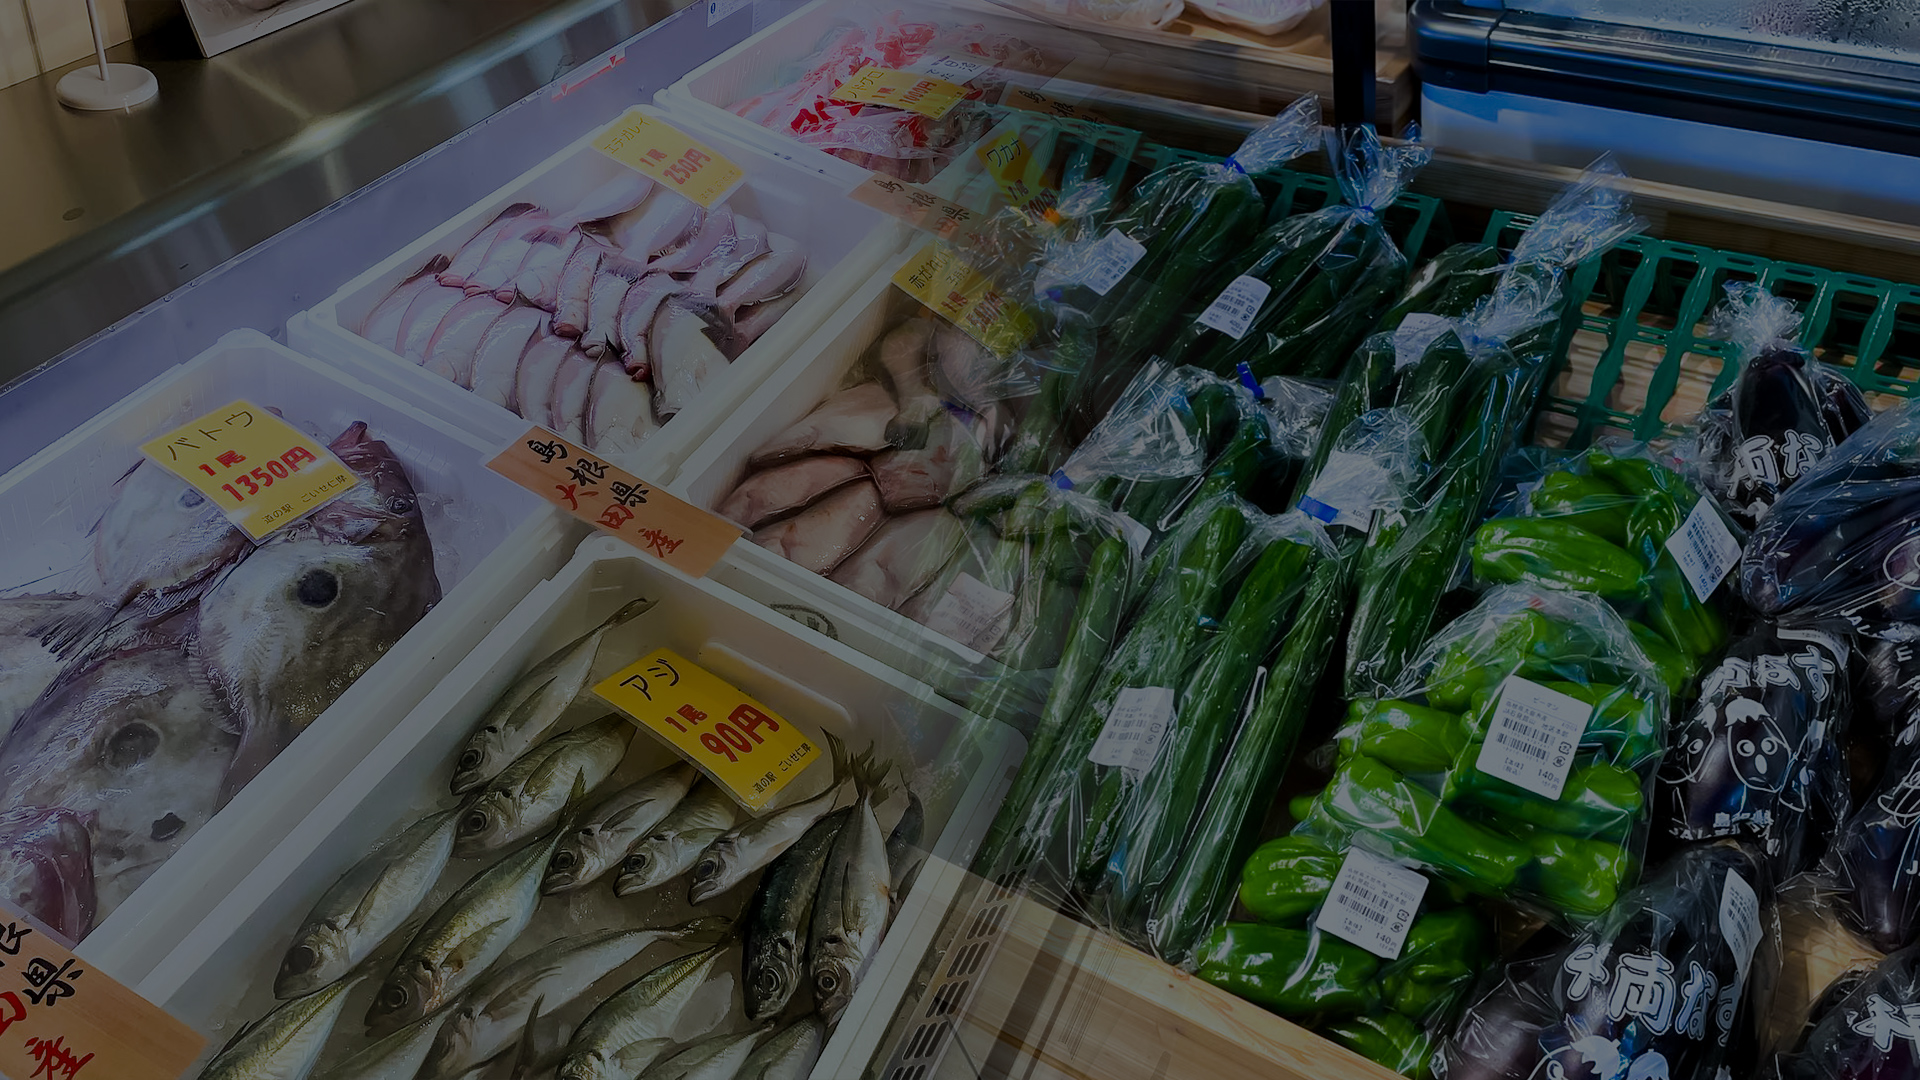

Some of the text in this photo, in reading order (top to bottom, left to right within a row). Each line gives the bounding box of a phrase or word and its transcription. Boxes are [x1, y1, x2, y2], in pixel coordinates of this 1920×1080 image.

[603, 117, 651, 154] エテガレイ
[986, 137, 1022, 168] ワカナ
[662, 148, 712, 185] 250円
[873, 178, 972, 222] 島根県
[167, 410, 254, 461] バトウ
[198, 449, 247, 477] 1尾
[221, 446, 318, 503] 1350円
[526, 438, 650, 508] 島根県
[261, 502, 295, 526] 道の駅
[554, 482, 685, 559] 大田産
[619, 658, 681, 702] アジ
[664, 702, 709, 733] 1尾
[699, 703, 781, 763] 90円
[752, 742, 813, 795] 道の駅 ごいせ仁摩
